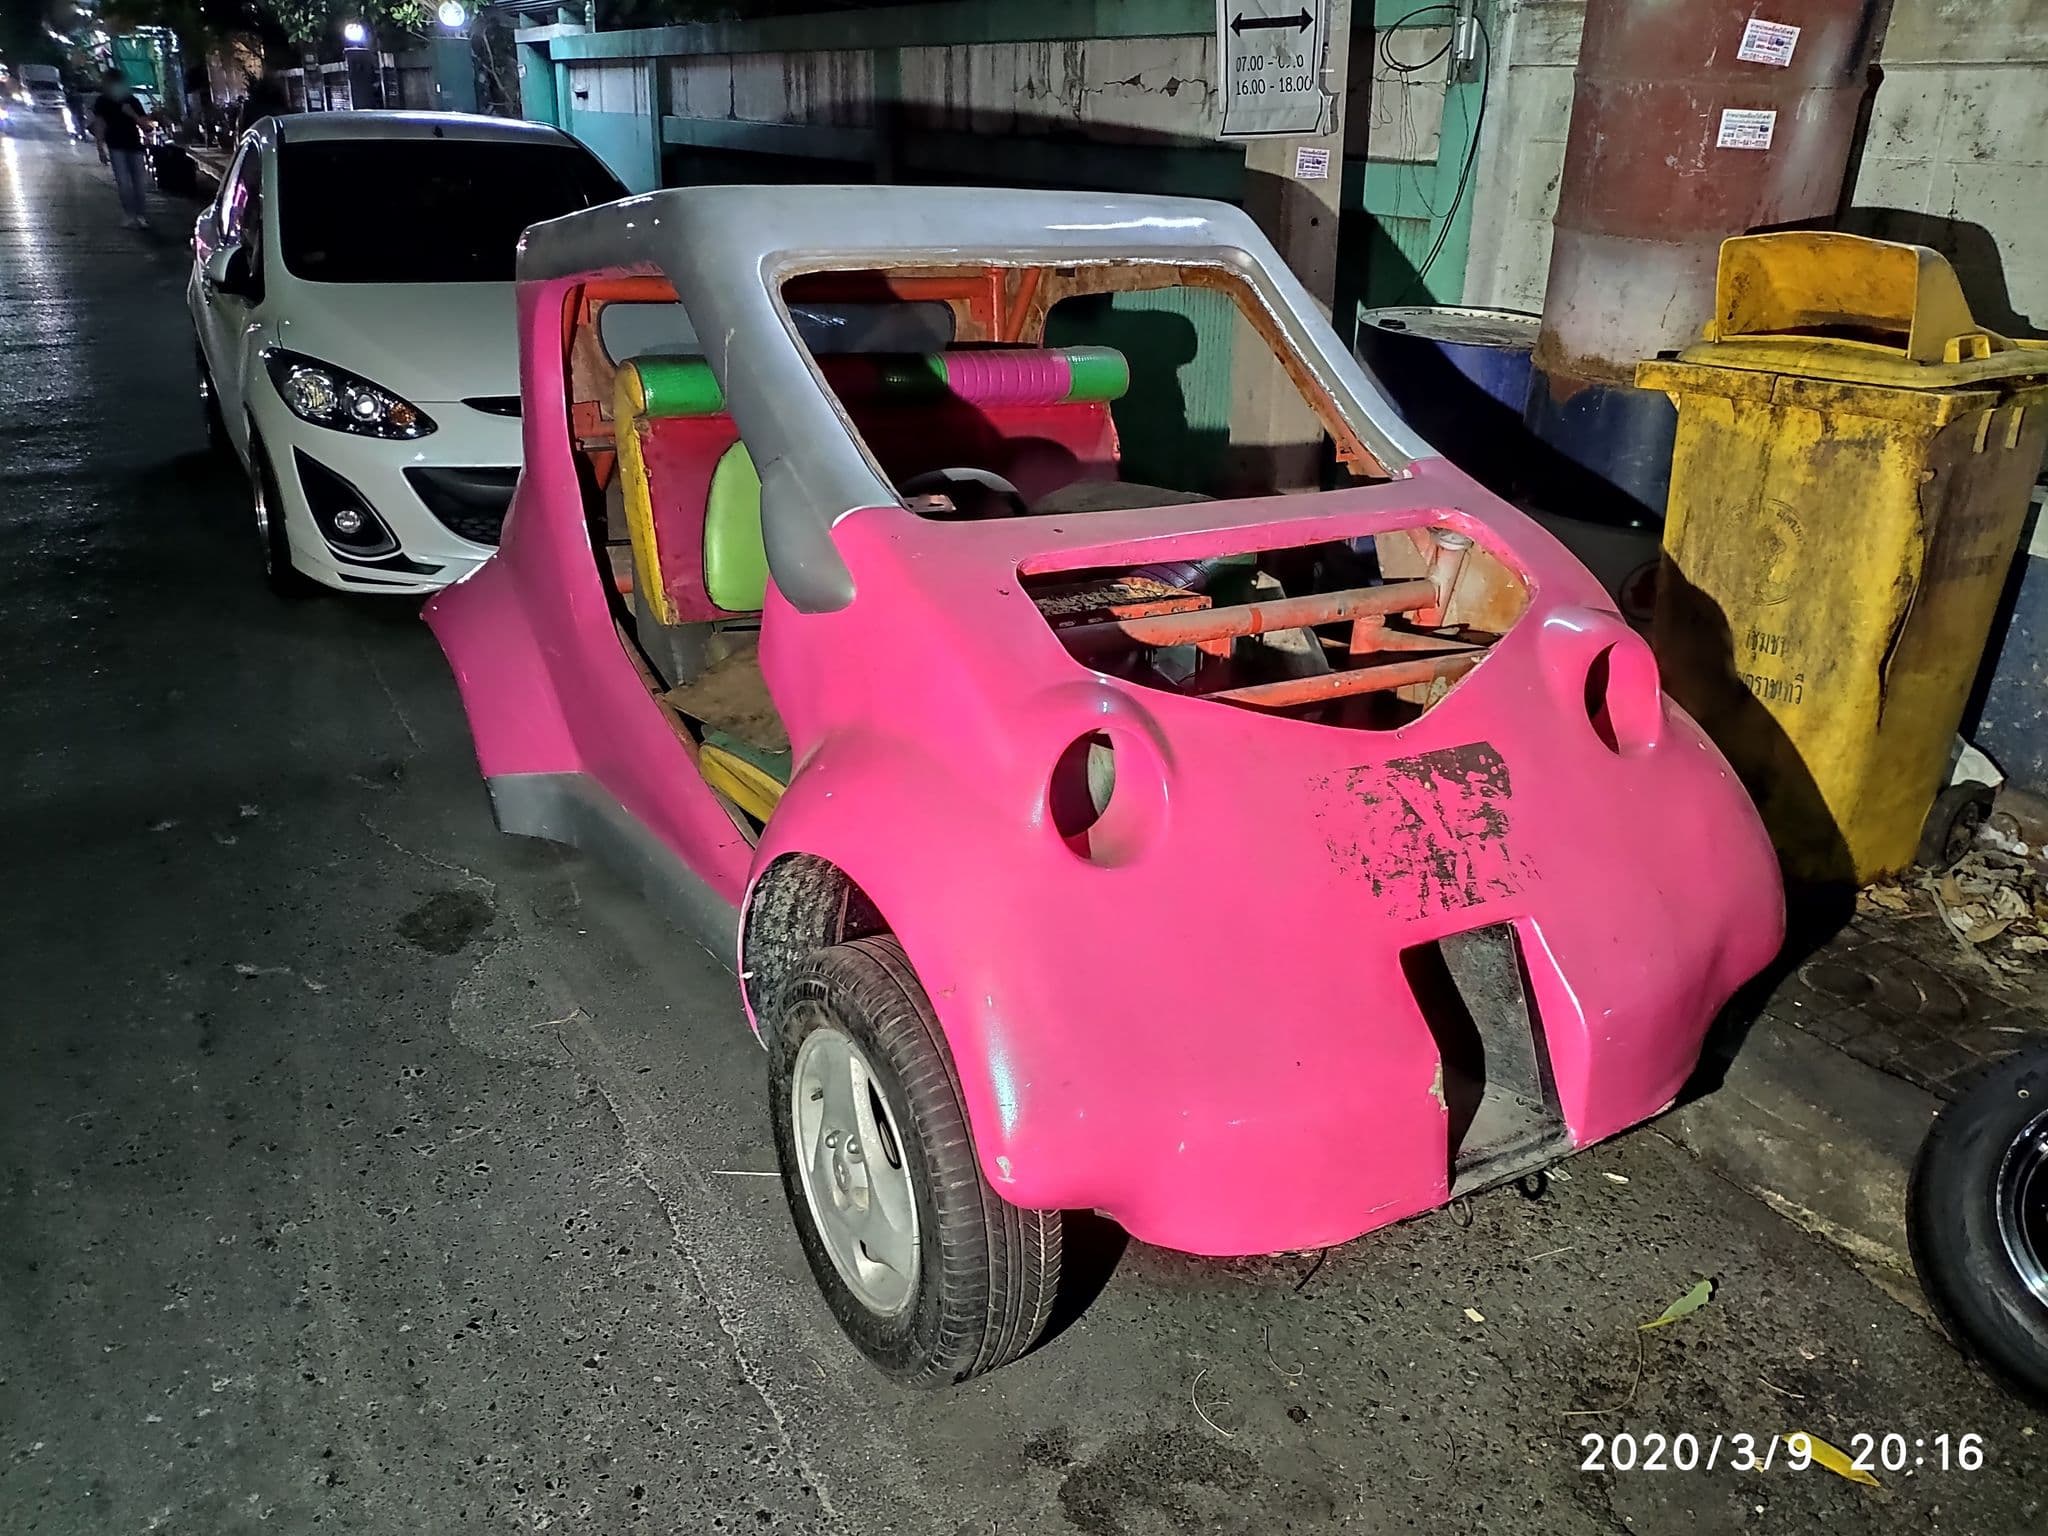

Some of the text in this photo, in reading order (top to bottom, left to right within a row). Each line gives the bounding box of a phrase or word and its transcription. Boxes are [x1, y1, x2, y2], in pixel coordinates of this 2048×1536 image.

[1235, 55, 1264, 72] 07.00
[1235, 78, 1266, 95] 16.00
[1279, 75, 1312, 93] 18.00
